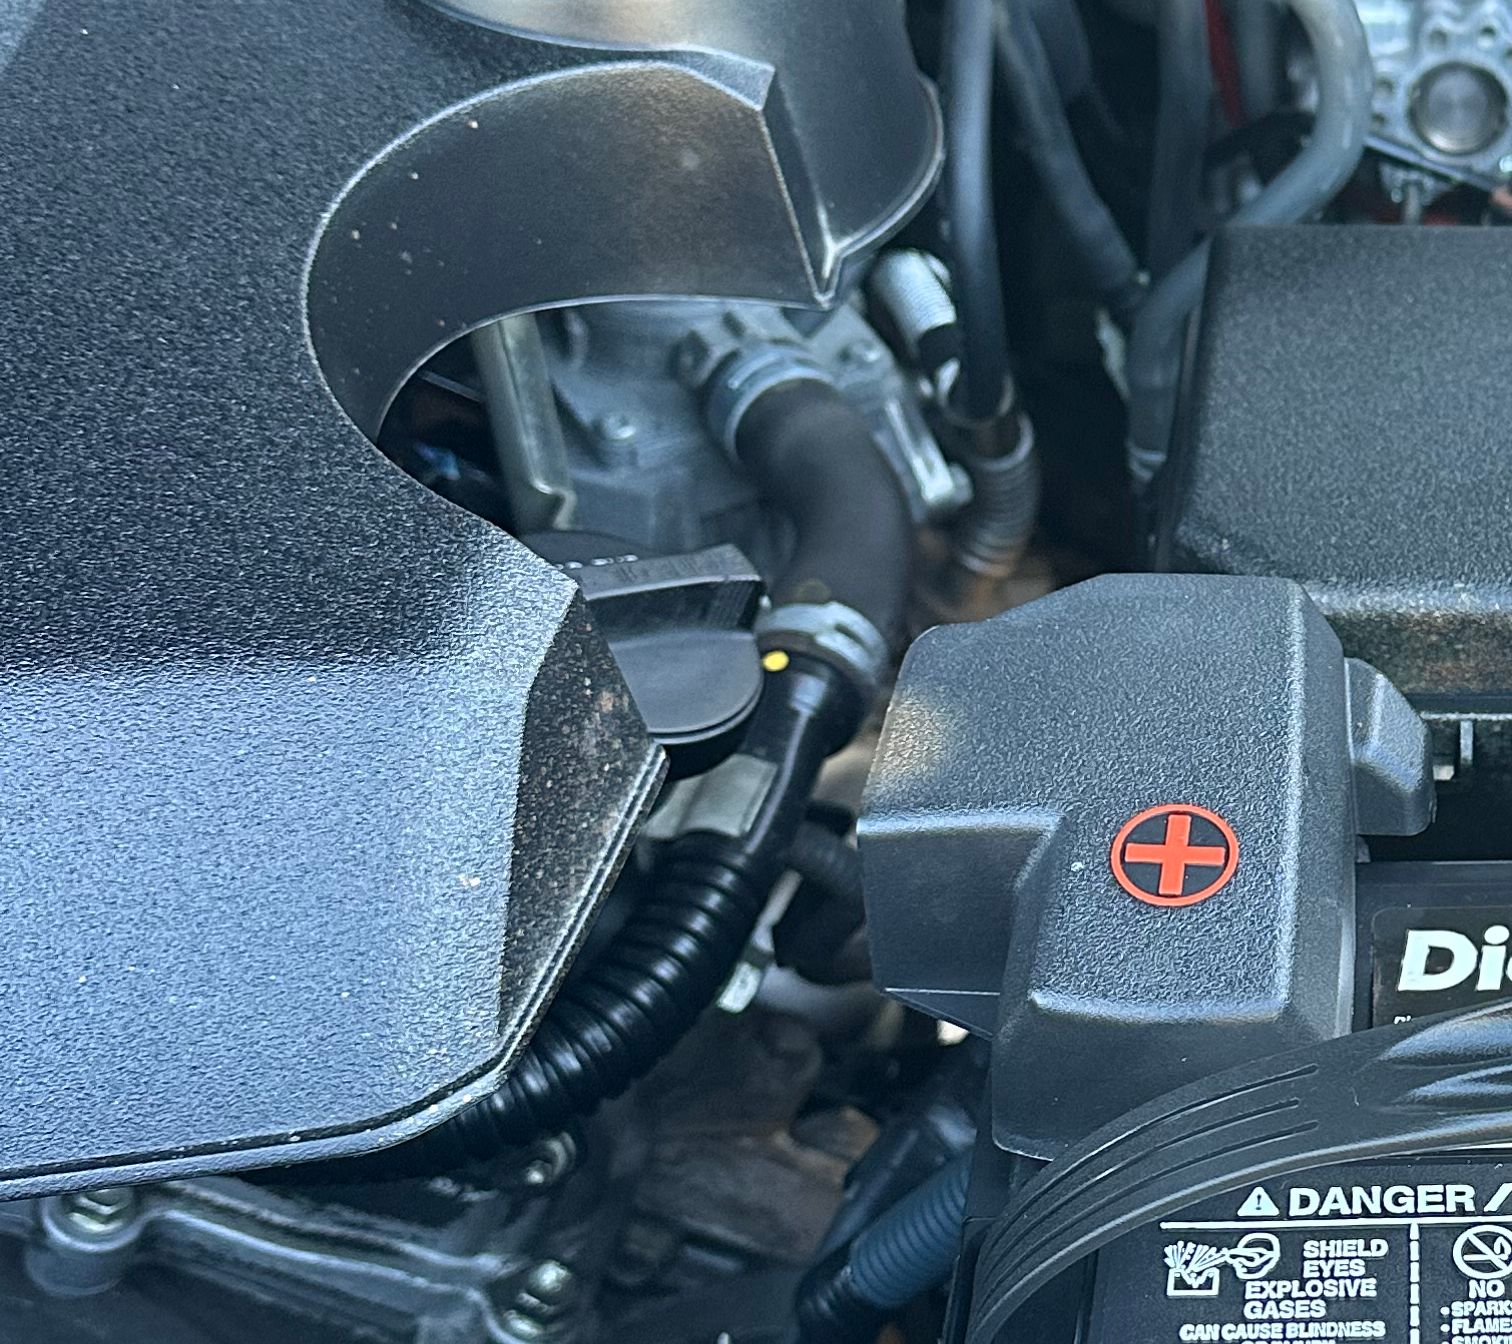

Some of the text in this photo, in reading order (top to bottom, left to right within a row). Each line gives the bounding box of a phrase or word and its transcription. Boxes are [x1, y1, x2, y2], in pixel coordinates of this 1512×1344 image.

[1289, 1184, 1475, 1216] DANGER
[1303, 1239, 1388, 1258] SHIELD
[1303, 1259, 1366, 1278] EYES
[1245, 1277, 1377, 1299] EXPLOSIVE
[1468, 1279, 1505, 1299] NO
[1243, 1299, 1326, 1319] GASES
[1179, 1320, 1386, 1341] CAN CAUSE BLINDNESS
